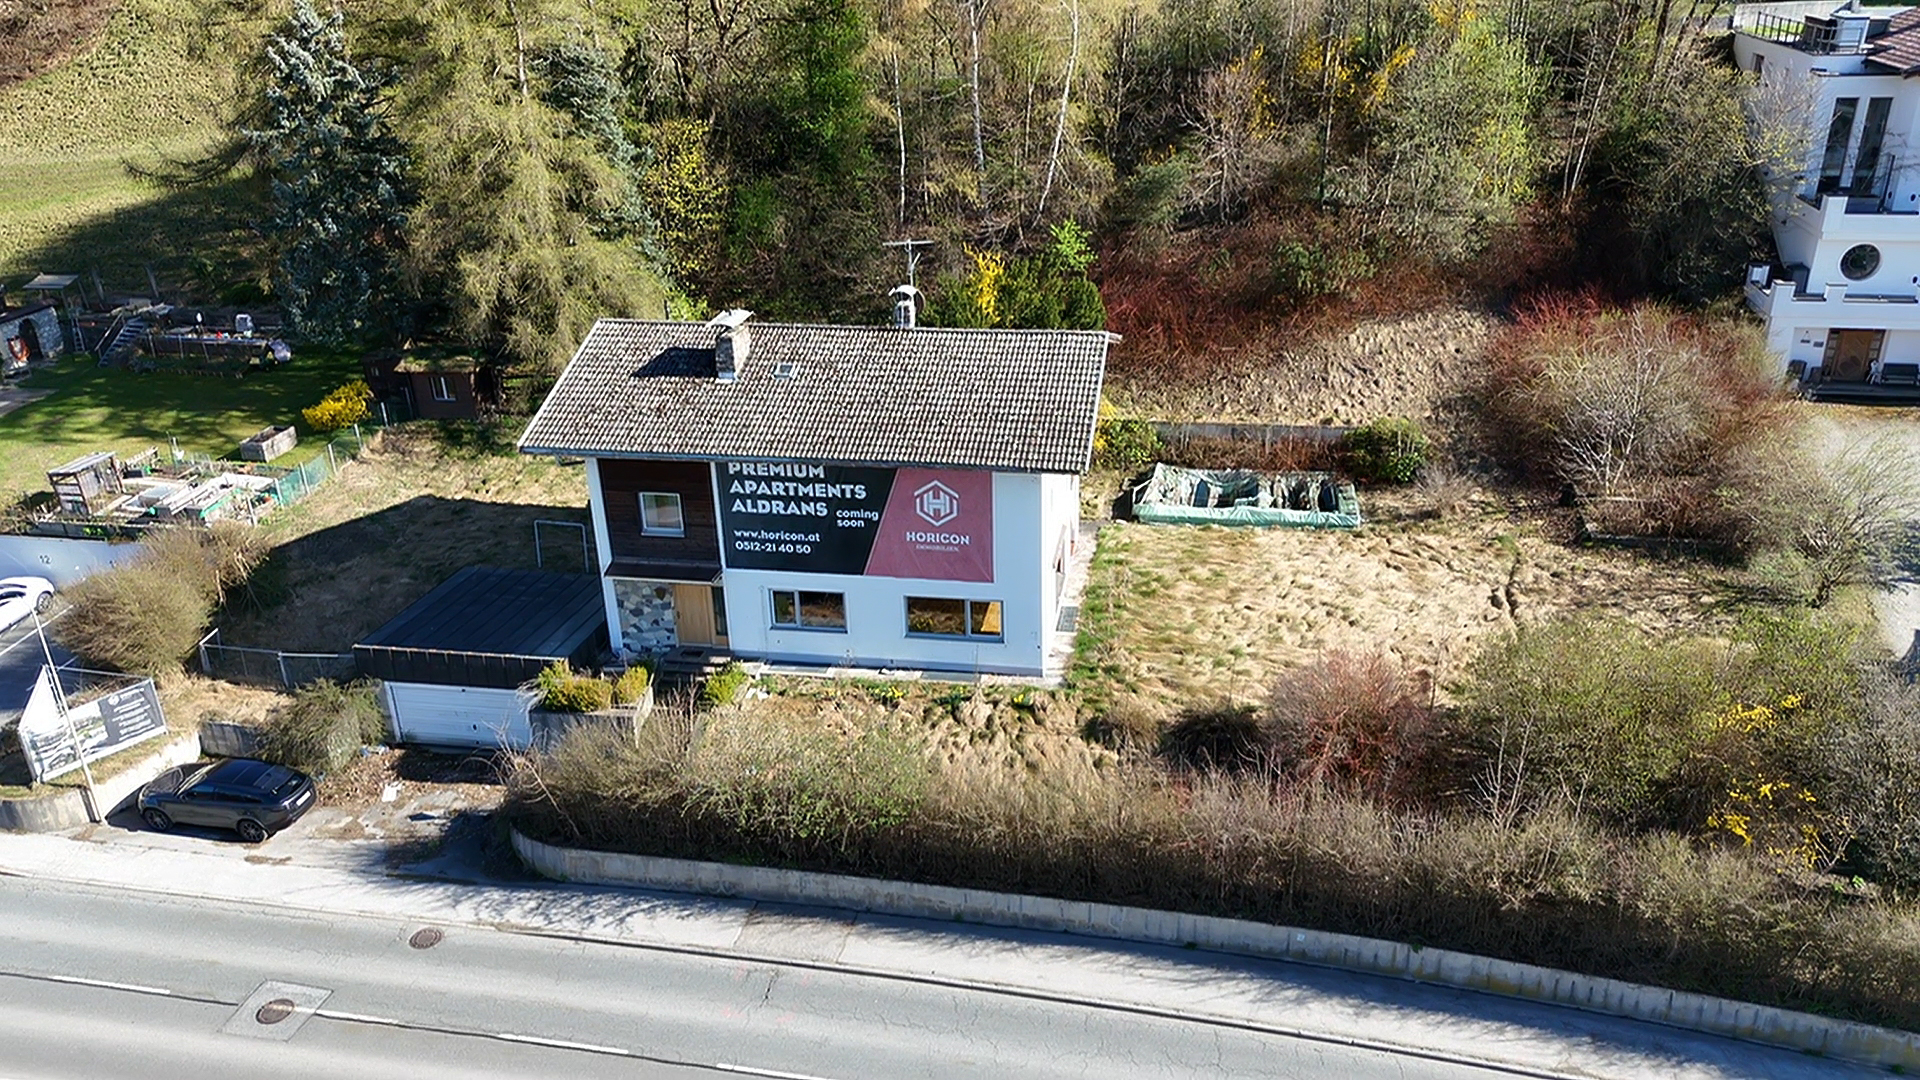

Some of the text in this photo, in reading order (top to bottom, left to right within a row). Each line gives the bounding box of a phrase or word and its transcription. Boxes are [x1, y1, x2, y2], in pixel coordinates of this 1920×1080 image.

[728, 462, 825, 478] PREMIUM
[730, 480, 867, 499] APARTMENTS
[731, 499, 828, 517] ALDRANS
[836, 509, 879, 521] coming
[734, 530, 820, 542] www.horicon.at
[906, 531, 970, 545] HORICON
[735, 541, 811, 554] 0512-21 40 50
[39, 555, 51, 564] 12
